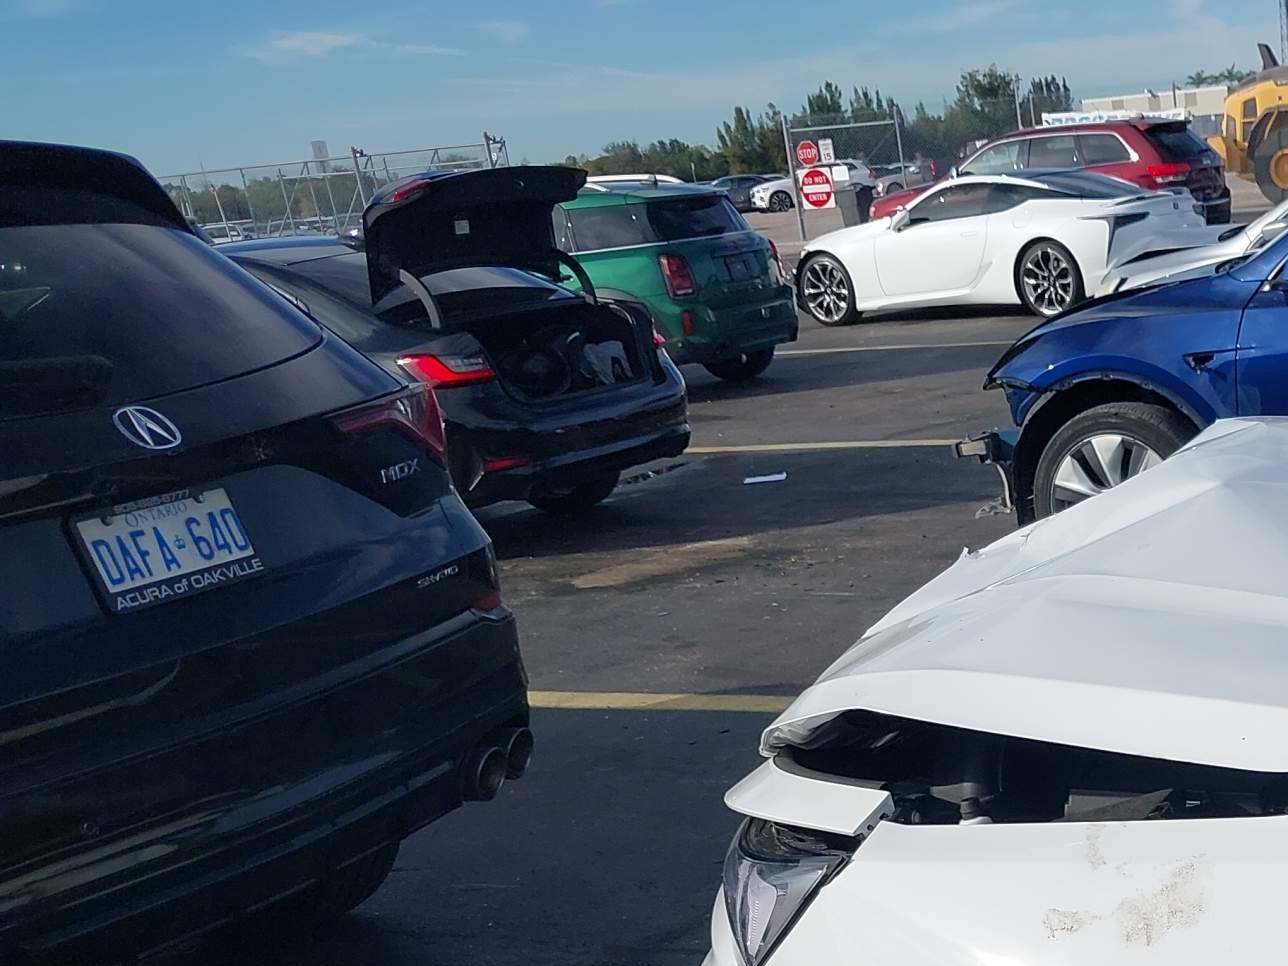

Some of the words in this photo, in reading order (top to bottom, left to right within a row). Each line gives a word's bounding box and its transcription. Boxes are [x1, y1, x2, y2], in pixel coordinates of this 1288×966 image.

[799, 149, 816, 159] STOP
[804, 176, 813, 185] DO
[814, 175, 827, 184] NOT
[808, 193, 828, 202] ENTER
[381, 458, 421, 483] MDX
[91, 526, 182, 586] DAFA
[185, 507, 250, 561] 640
[116, 584, 174, 611] ACURA
[174, 579, 190, 594] of
[191, 557, 265, 589] OAKVILLE
